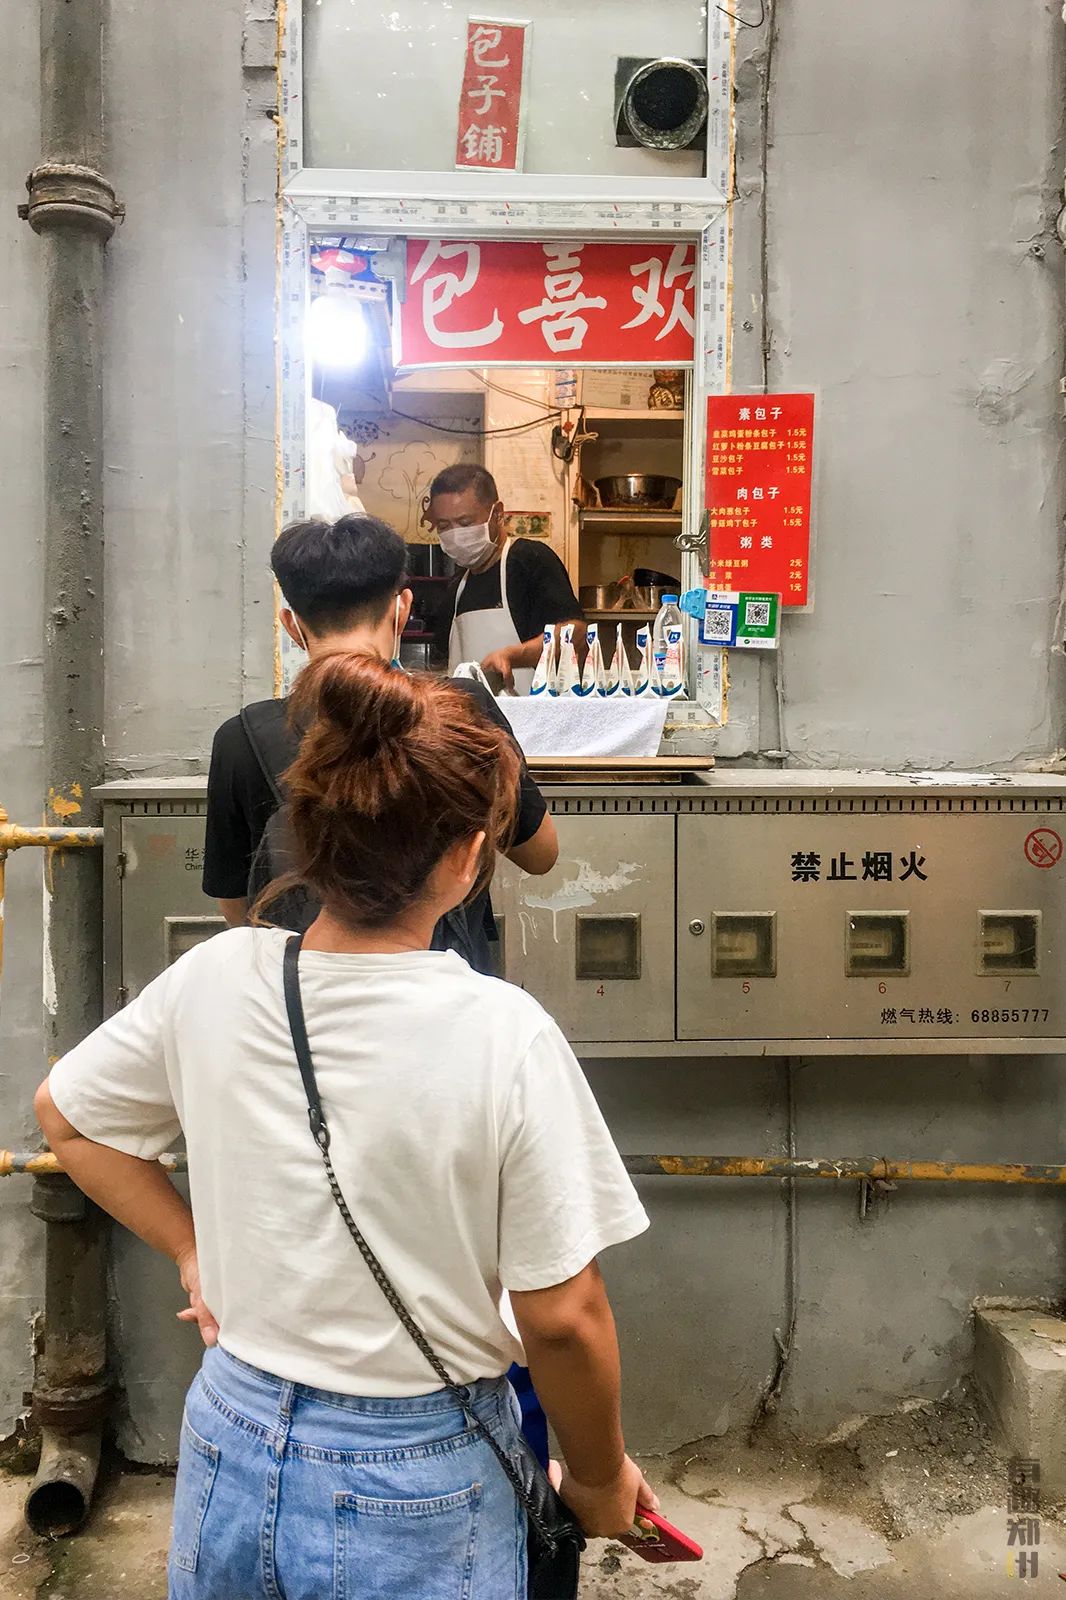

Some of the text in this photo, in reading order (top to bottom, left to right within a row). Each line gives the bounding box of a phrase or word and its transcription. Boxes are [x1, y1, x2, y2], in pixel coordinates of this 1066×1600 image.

[738, 406, 783, 421] 素包子
[787, 428, 807, 437] 1.5元
[787, 440, 807, 449] 1.5元
[711, 453, 806, 464] 豆沙包子 1.5元
[786, 465, 806, 474] 1.5元
[736, 486, 780, 501] 肉包子
[783, 506, 803, 515] 1.5元
[709, 518, 803, 528] 香菇鸡丁包子 1.5元
[739, 535, 774, 549] 粥类
[709, 558, 803, 568] 小米绿豆粥 2元
[789, 571, 802, 580] 2元
[790, 583, 802, 592] 1元
[790, 851, 928, 882] 禁止烟火
[596, 984, 605, 997] 4
[741, 981, 751, 995] 5
[878, 981, 888, 995] 6
[1003, 980, 1013, 993] 7
